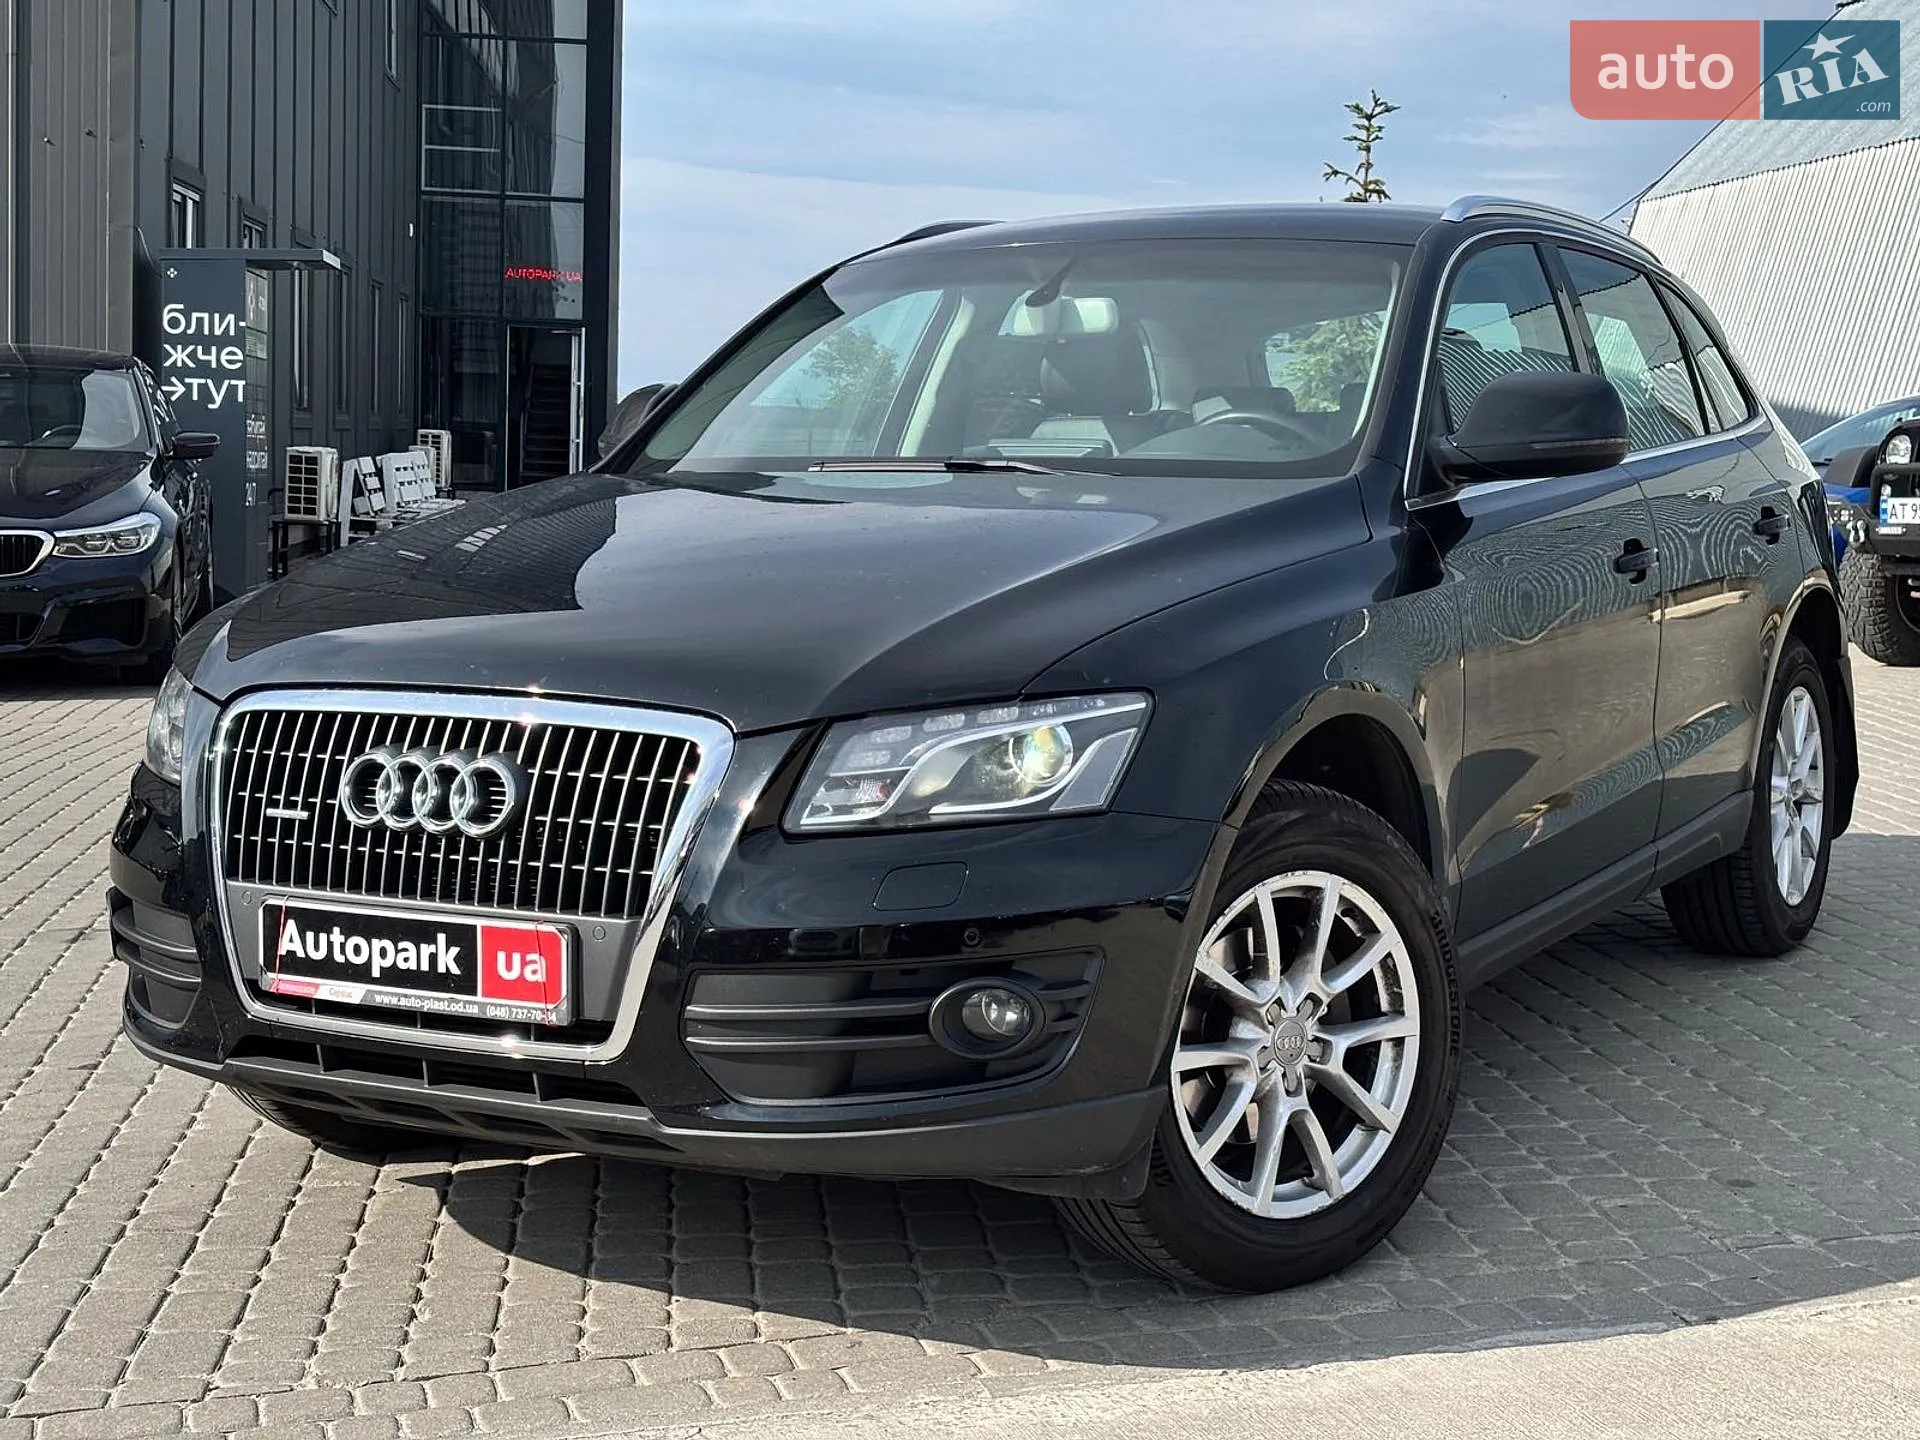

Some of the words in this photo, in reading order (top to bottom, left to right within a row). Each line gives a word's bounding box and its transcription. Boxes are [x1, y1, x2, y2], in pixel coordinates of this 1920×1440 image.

[162, 303, 246, 336] бли-
[163, 344, 244, 370] жче
[184, 379, 246, 409] тут
[279, 918, 462, 978] Autopark
[496, 950, 547, 982] ua
[374, 993, 479, 1014] www.auto-plast.od.ua
